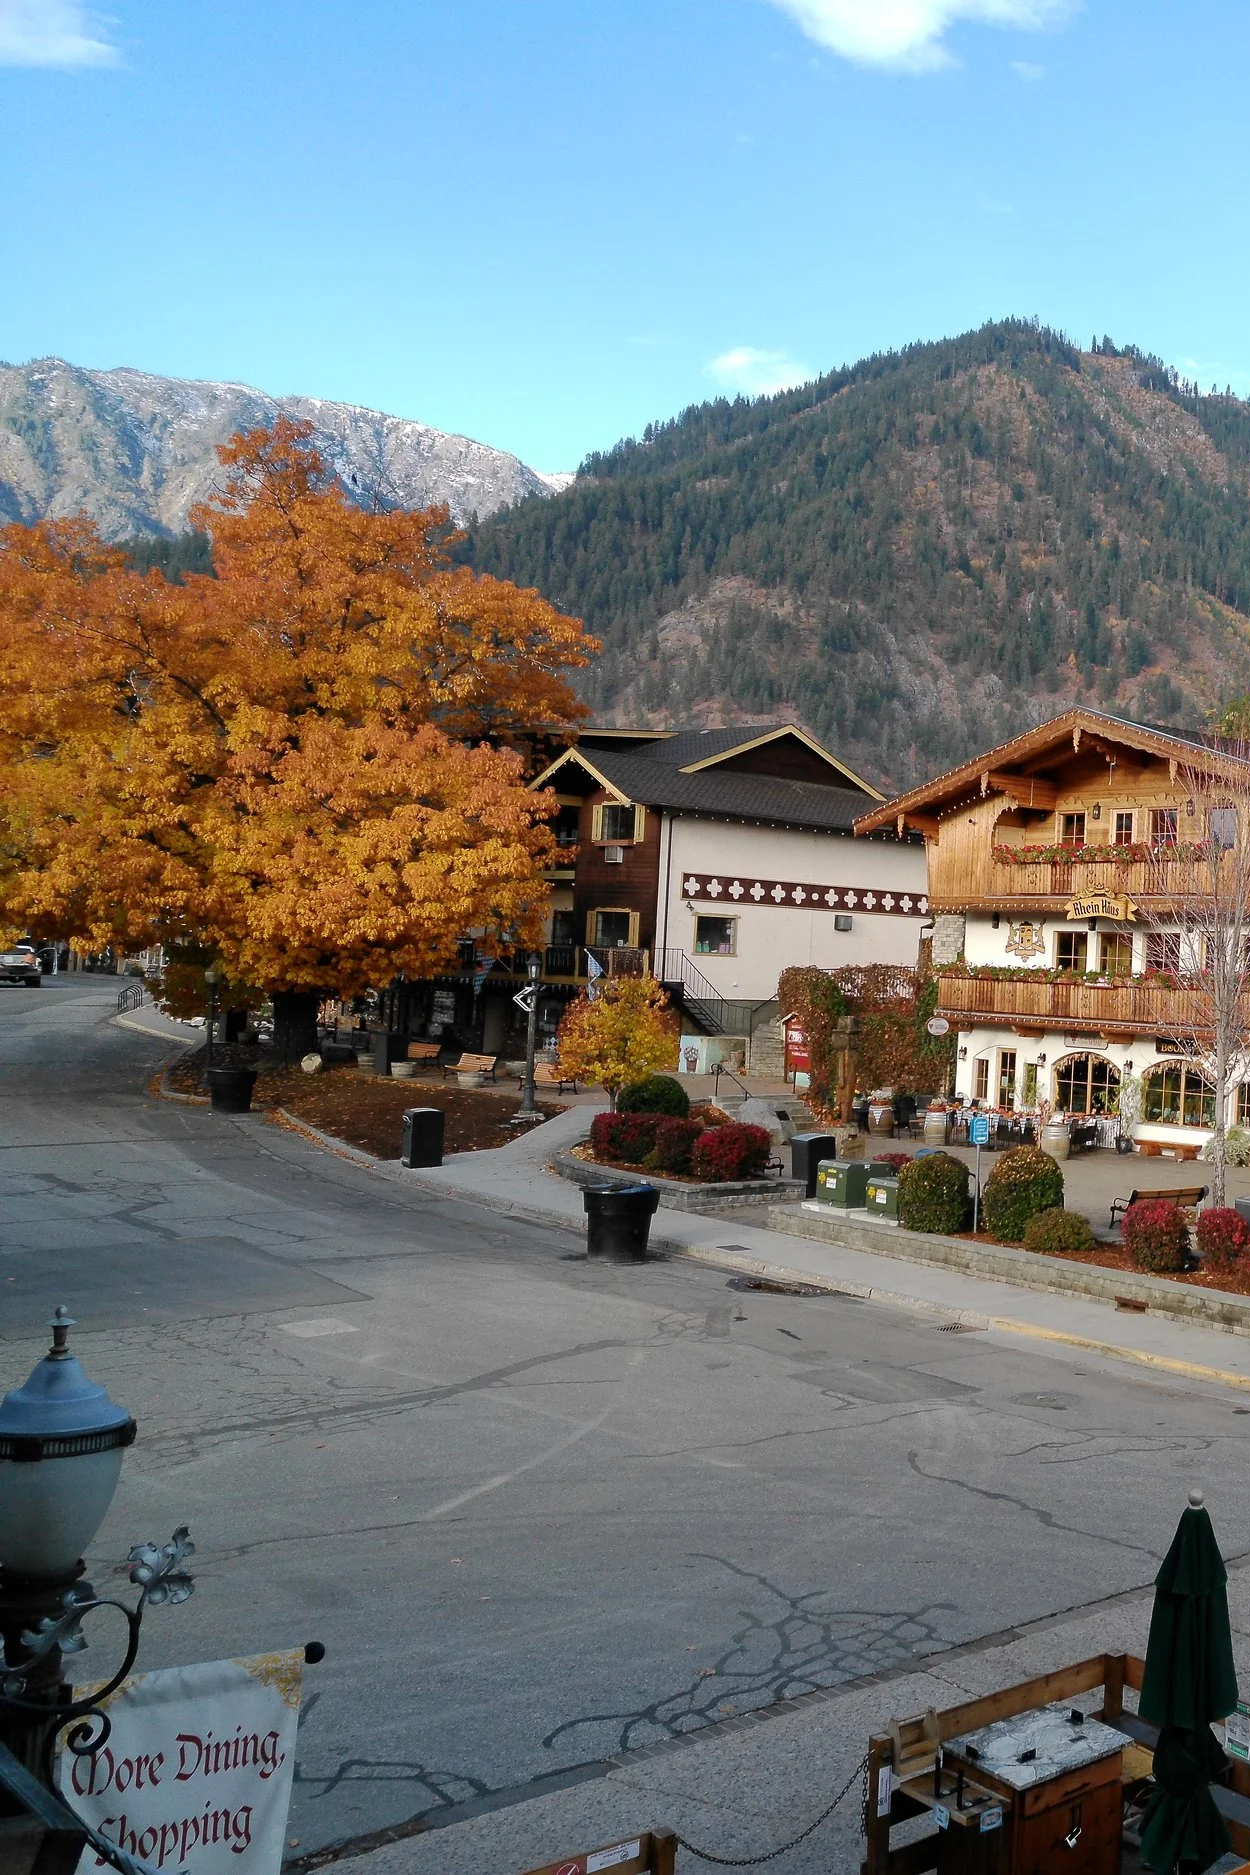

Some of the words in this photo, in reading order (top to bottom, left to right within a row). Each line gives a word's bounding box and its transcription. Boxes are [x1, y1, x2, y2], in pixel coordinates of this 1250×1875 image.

[1073, 902, 1100, 916] Rhein
[71, 1746, 164, 1797] More
[174, 1725, 286, 1780] Dining,
